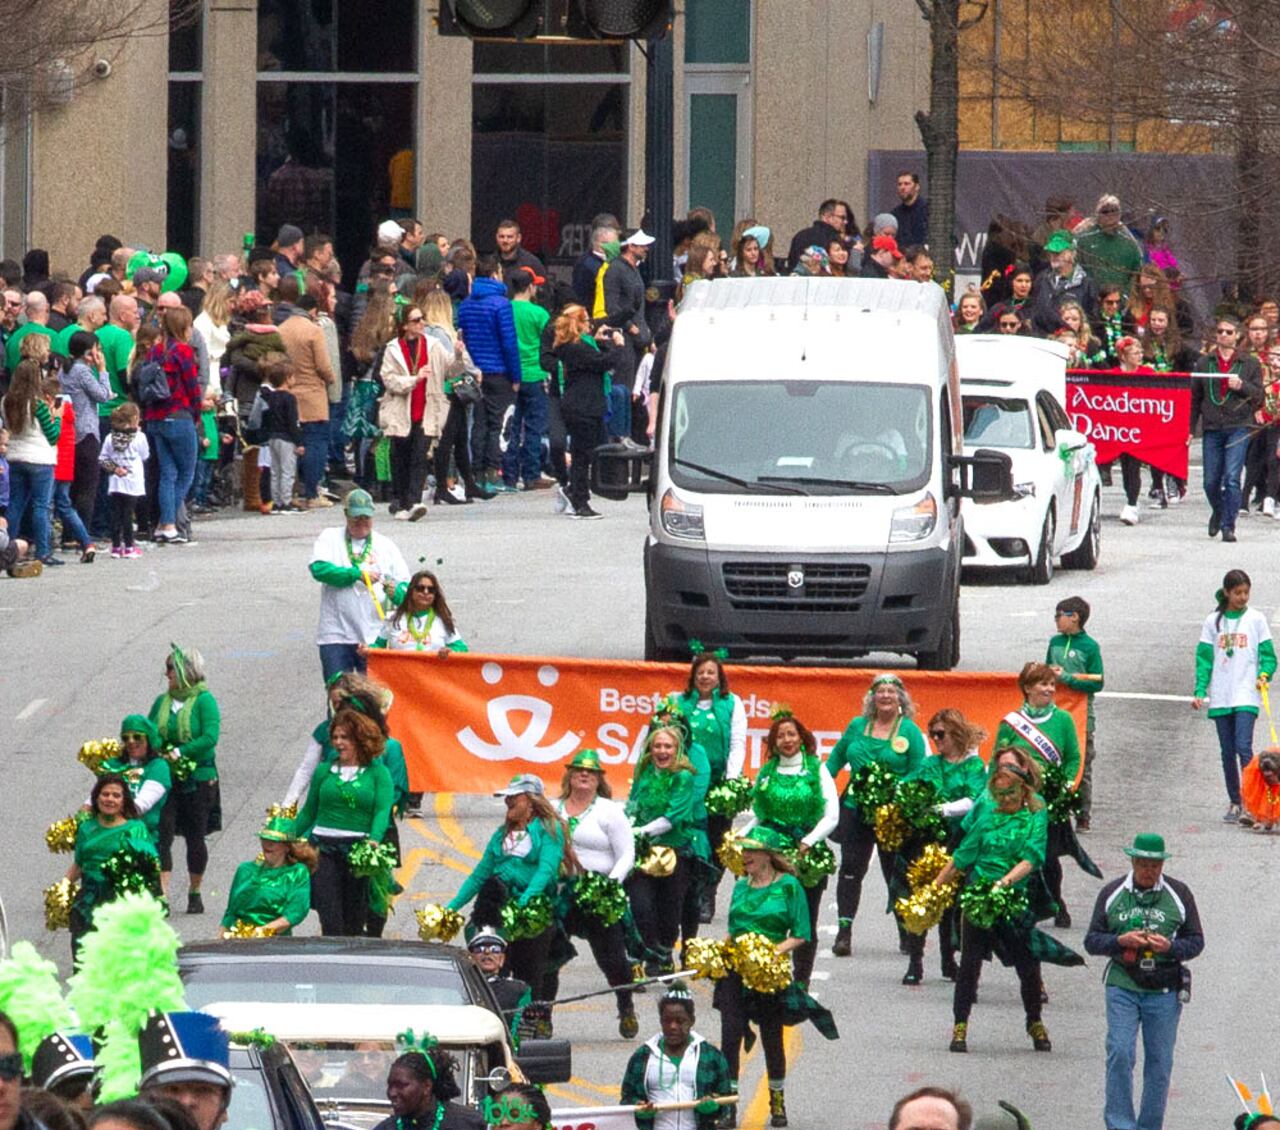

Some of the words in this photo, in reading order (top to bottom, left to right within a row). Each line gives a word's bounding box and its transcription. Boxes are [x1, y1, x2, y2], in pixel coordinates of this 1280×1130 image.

[1072, 385, 1175, 424] Academy
[1070, 412, 1142, 444] Dance
[599, 687, 663, 714] Best
